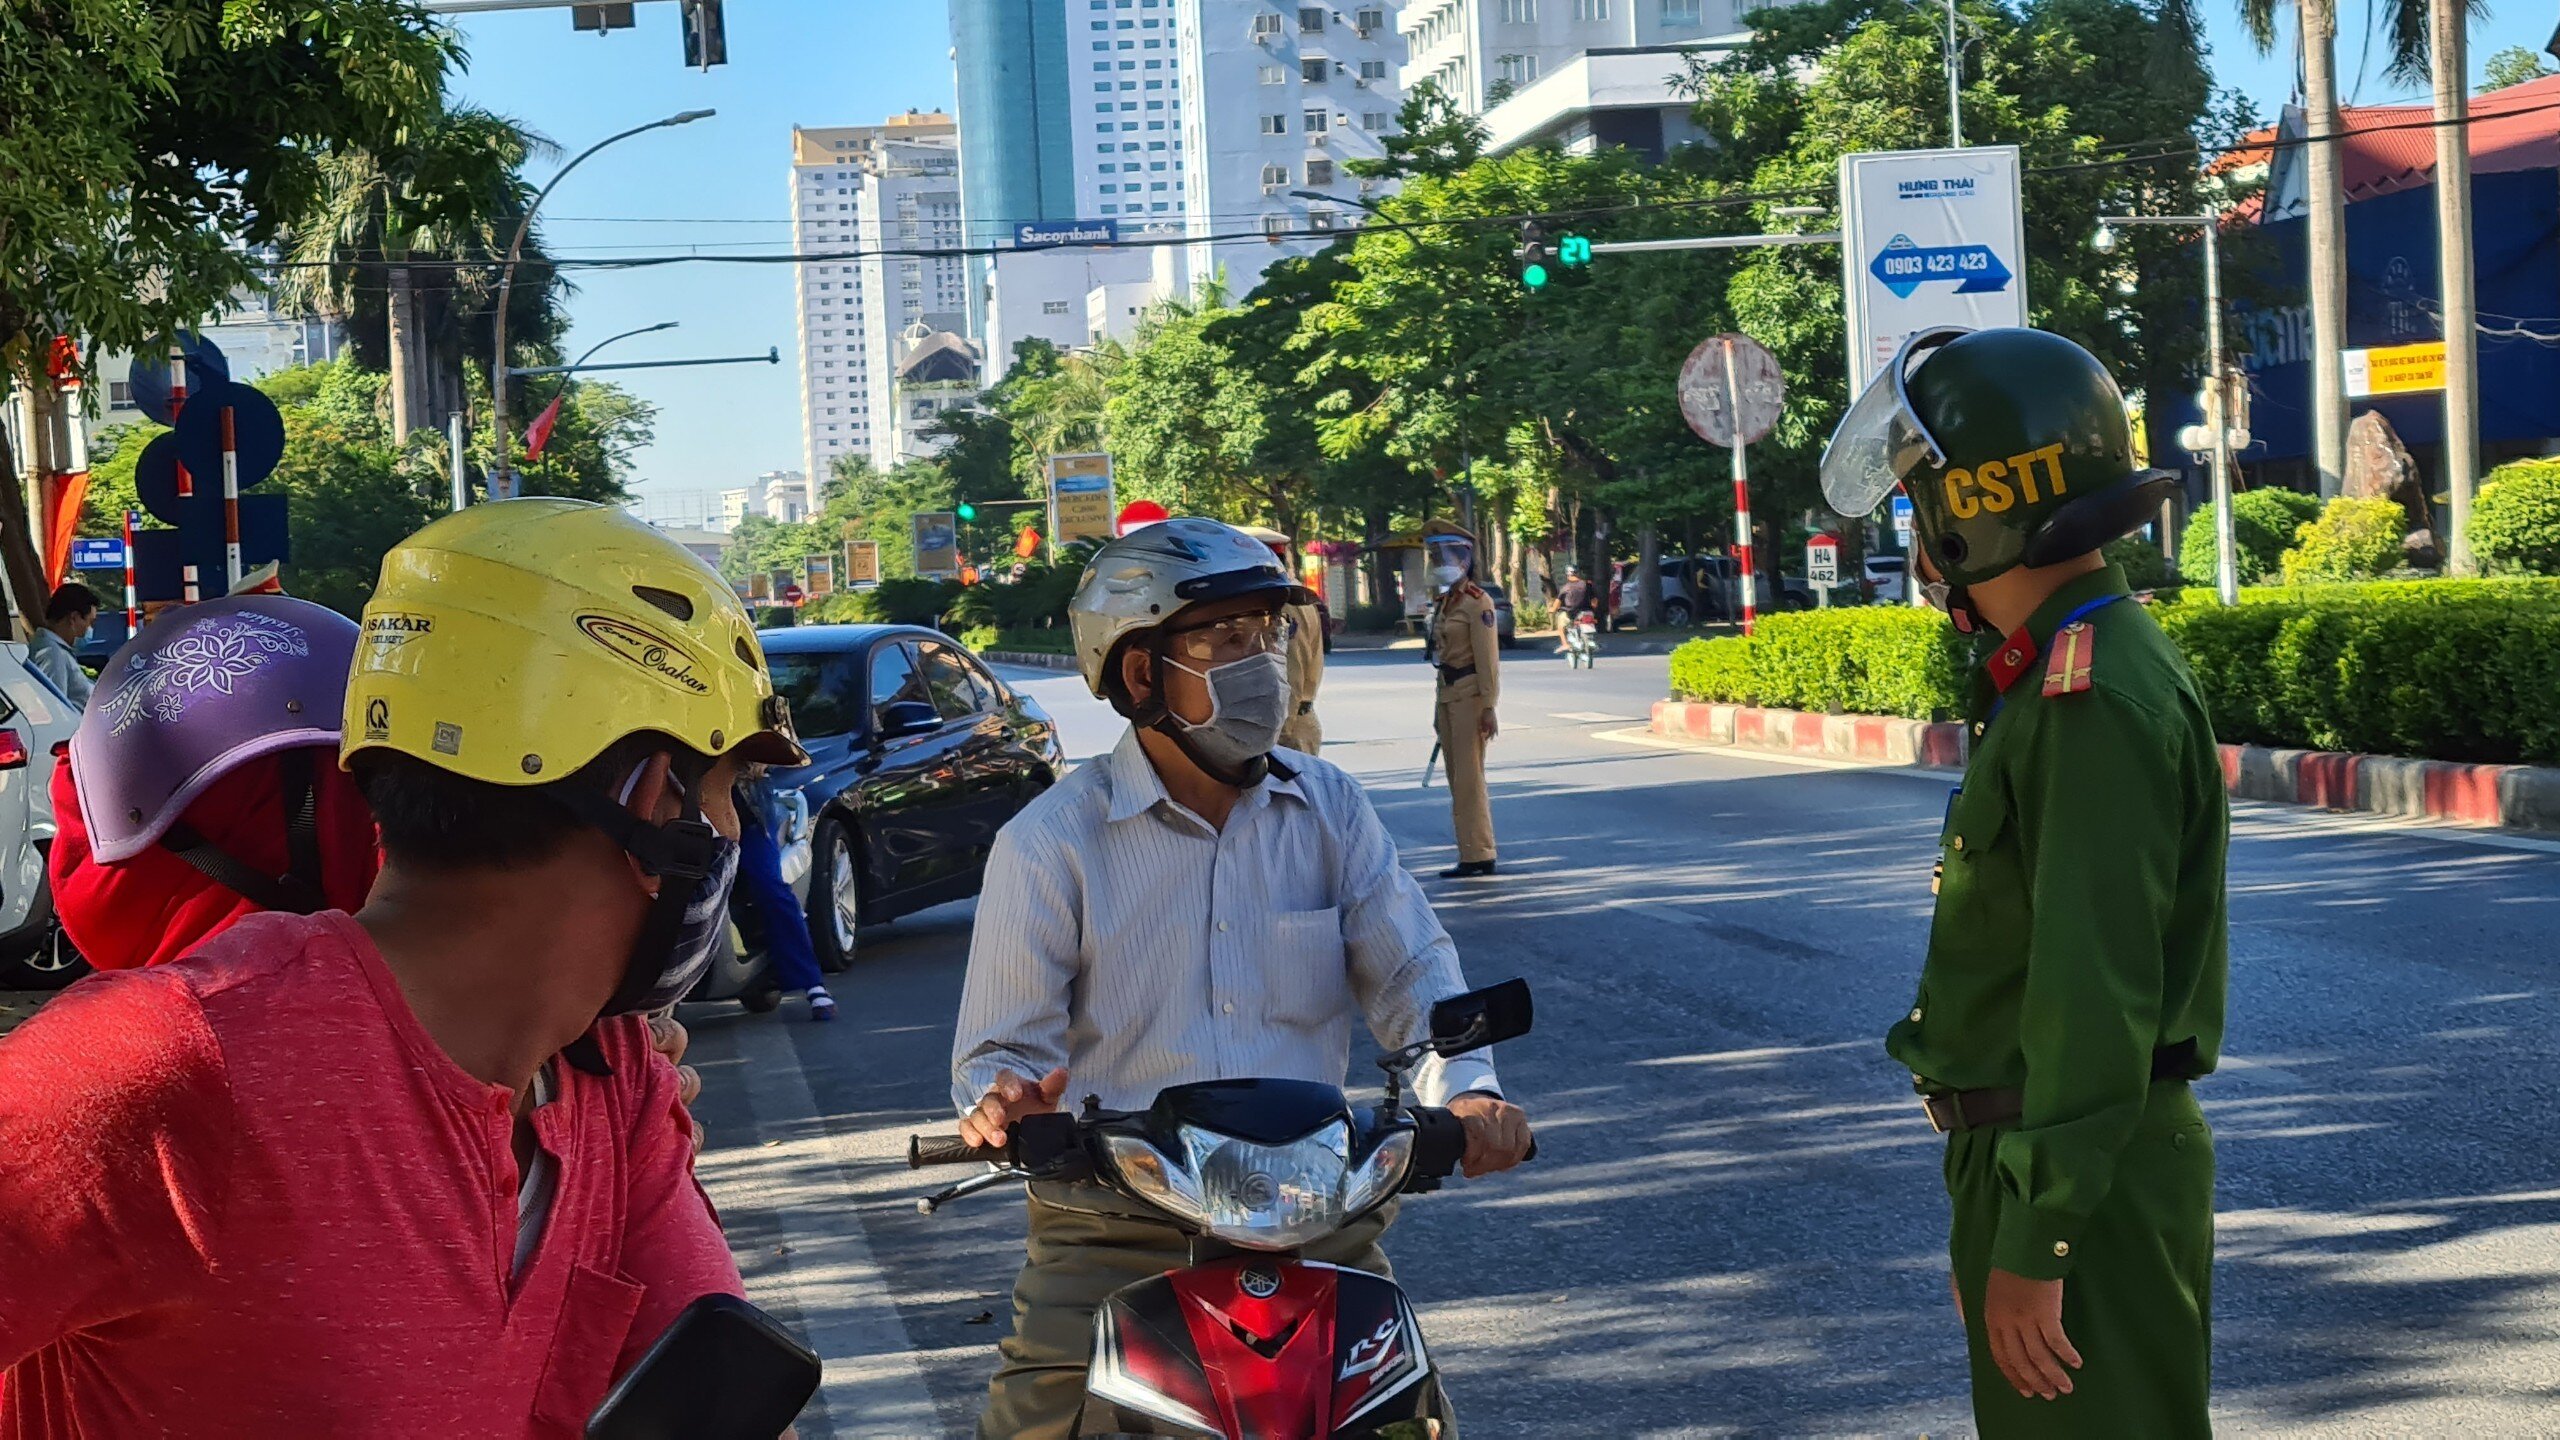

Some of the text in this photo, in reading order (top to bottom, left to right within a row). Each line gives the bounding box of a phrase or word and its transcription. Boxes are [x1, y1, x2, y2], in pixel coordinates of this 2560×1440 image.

[1021, 226, 1110, 243] Sacombank
[1885, 252, 1988, 275] 0903 423 423
[1945, 442, 2067, 519] CSTT
[1814, 549, 1831, 563] H4
[1810, 570, 1834, 581] 462
[643, 644, 708, 693] Osakar
